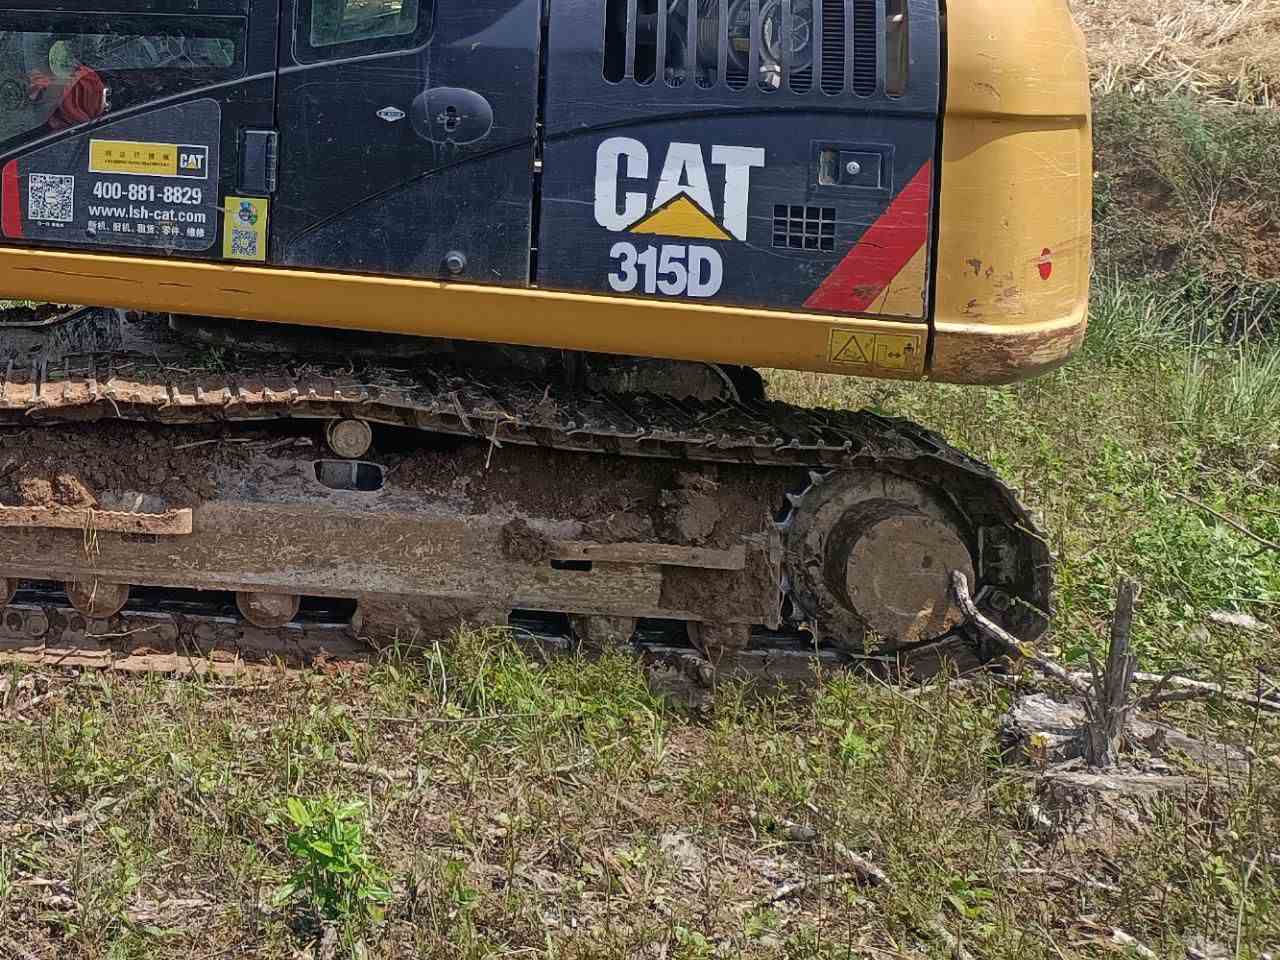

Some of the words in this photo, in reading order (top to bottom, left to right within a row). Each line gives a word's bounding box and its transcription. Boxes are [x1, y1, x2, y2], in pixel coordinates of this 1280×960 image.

[180, 153, 204, 169] CAT
[93, 181, 202, 204] 400-881-8829
[594, 136, 765, 241] CAT
[88, 204, 206, 223] www.lsh-cat.com
[608, 241, 724, 297] 315D
